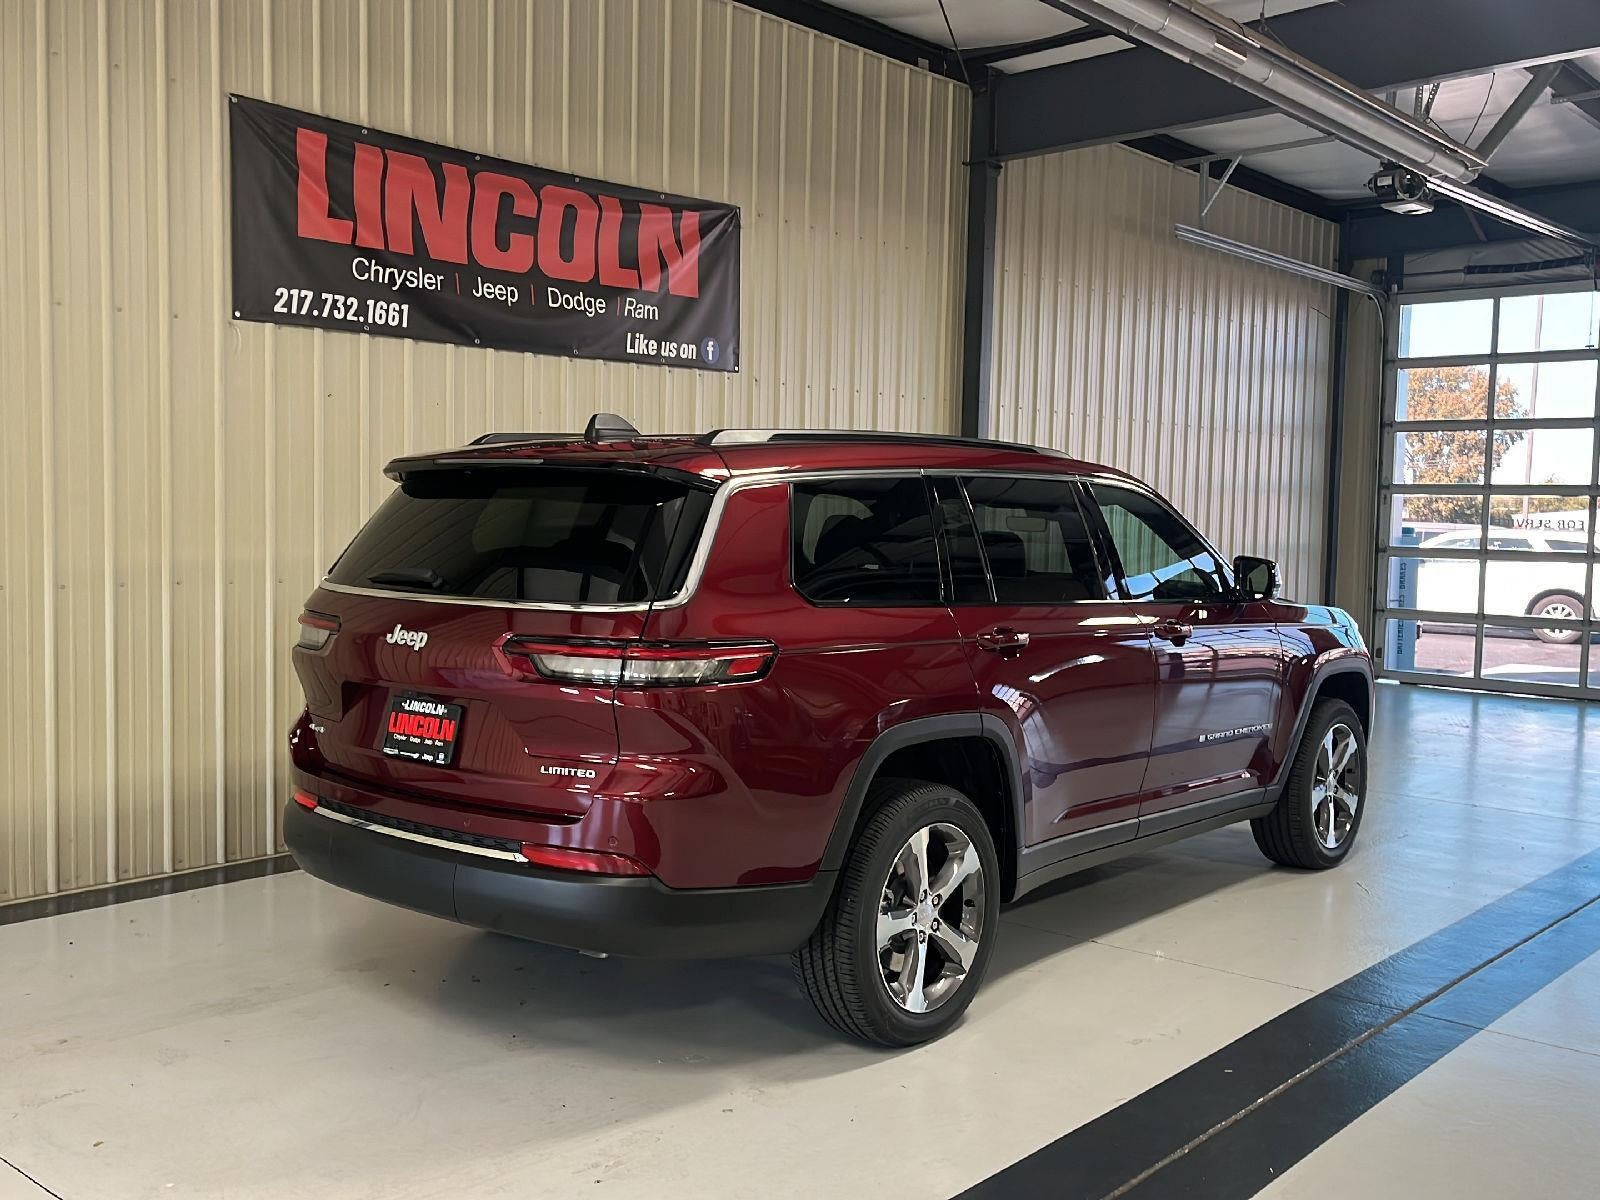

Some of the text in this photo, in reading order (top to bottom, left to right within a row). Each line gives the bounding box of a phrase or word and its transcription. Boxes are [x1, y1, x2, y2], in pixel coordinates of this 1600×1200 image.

[296, 127, 701, 298] LINCOLN
[352, 257, 659, 321] Chrysler Jeep Dodge Ram
[273, 287, 409, 328] 217.732.1661
[626, 332, 657, 356] Like
[660, 341, 677, 358] us
[680, 344, 697, 360] on
[386, 623, 428, 651] Jeep
[389, 712, 456, 741] LINCOLN
[540, 765, 596, 779] LIMITED
